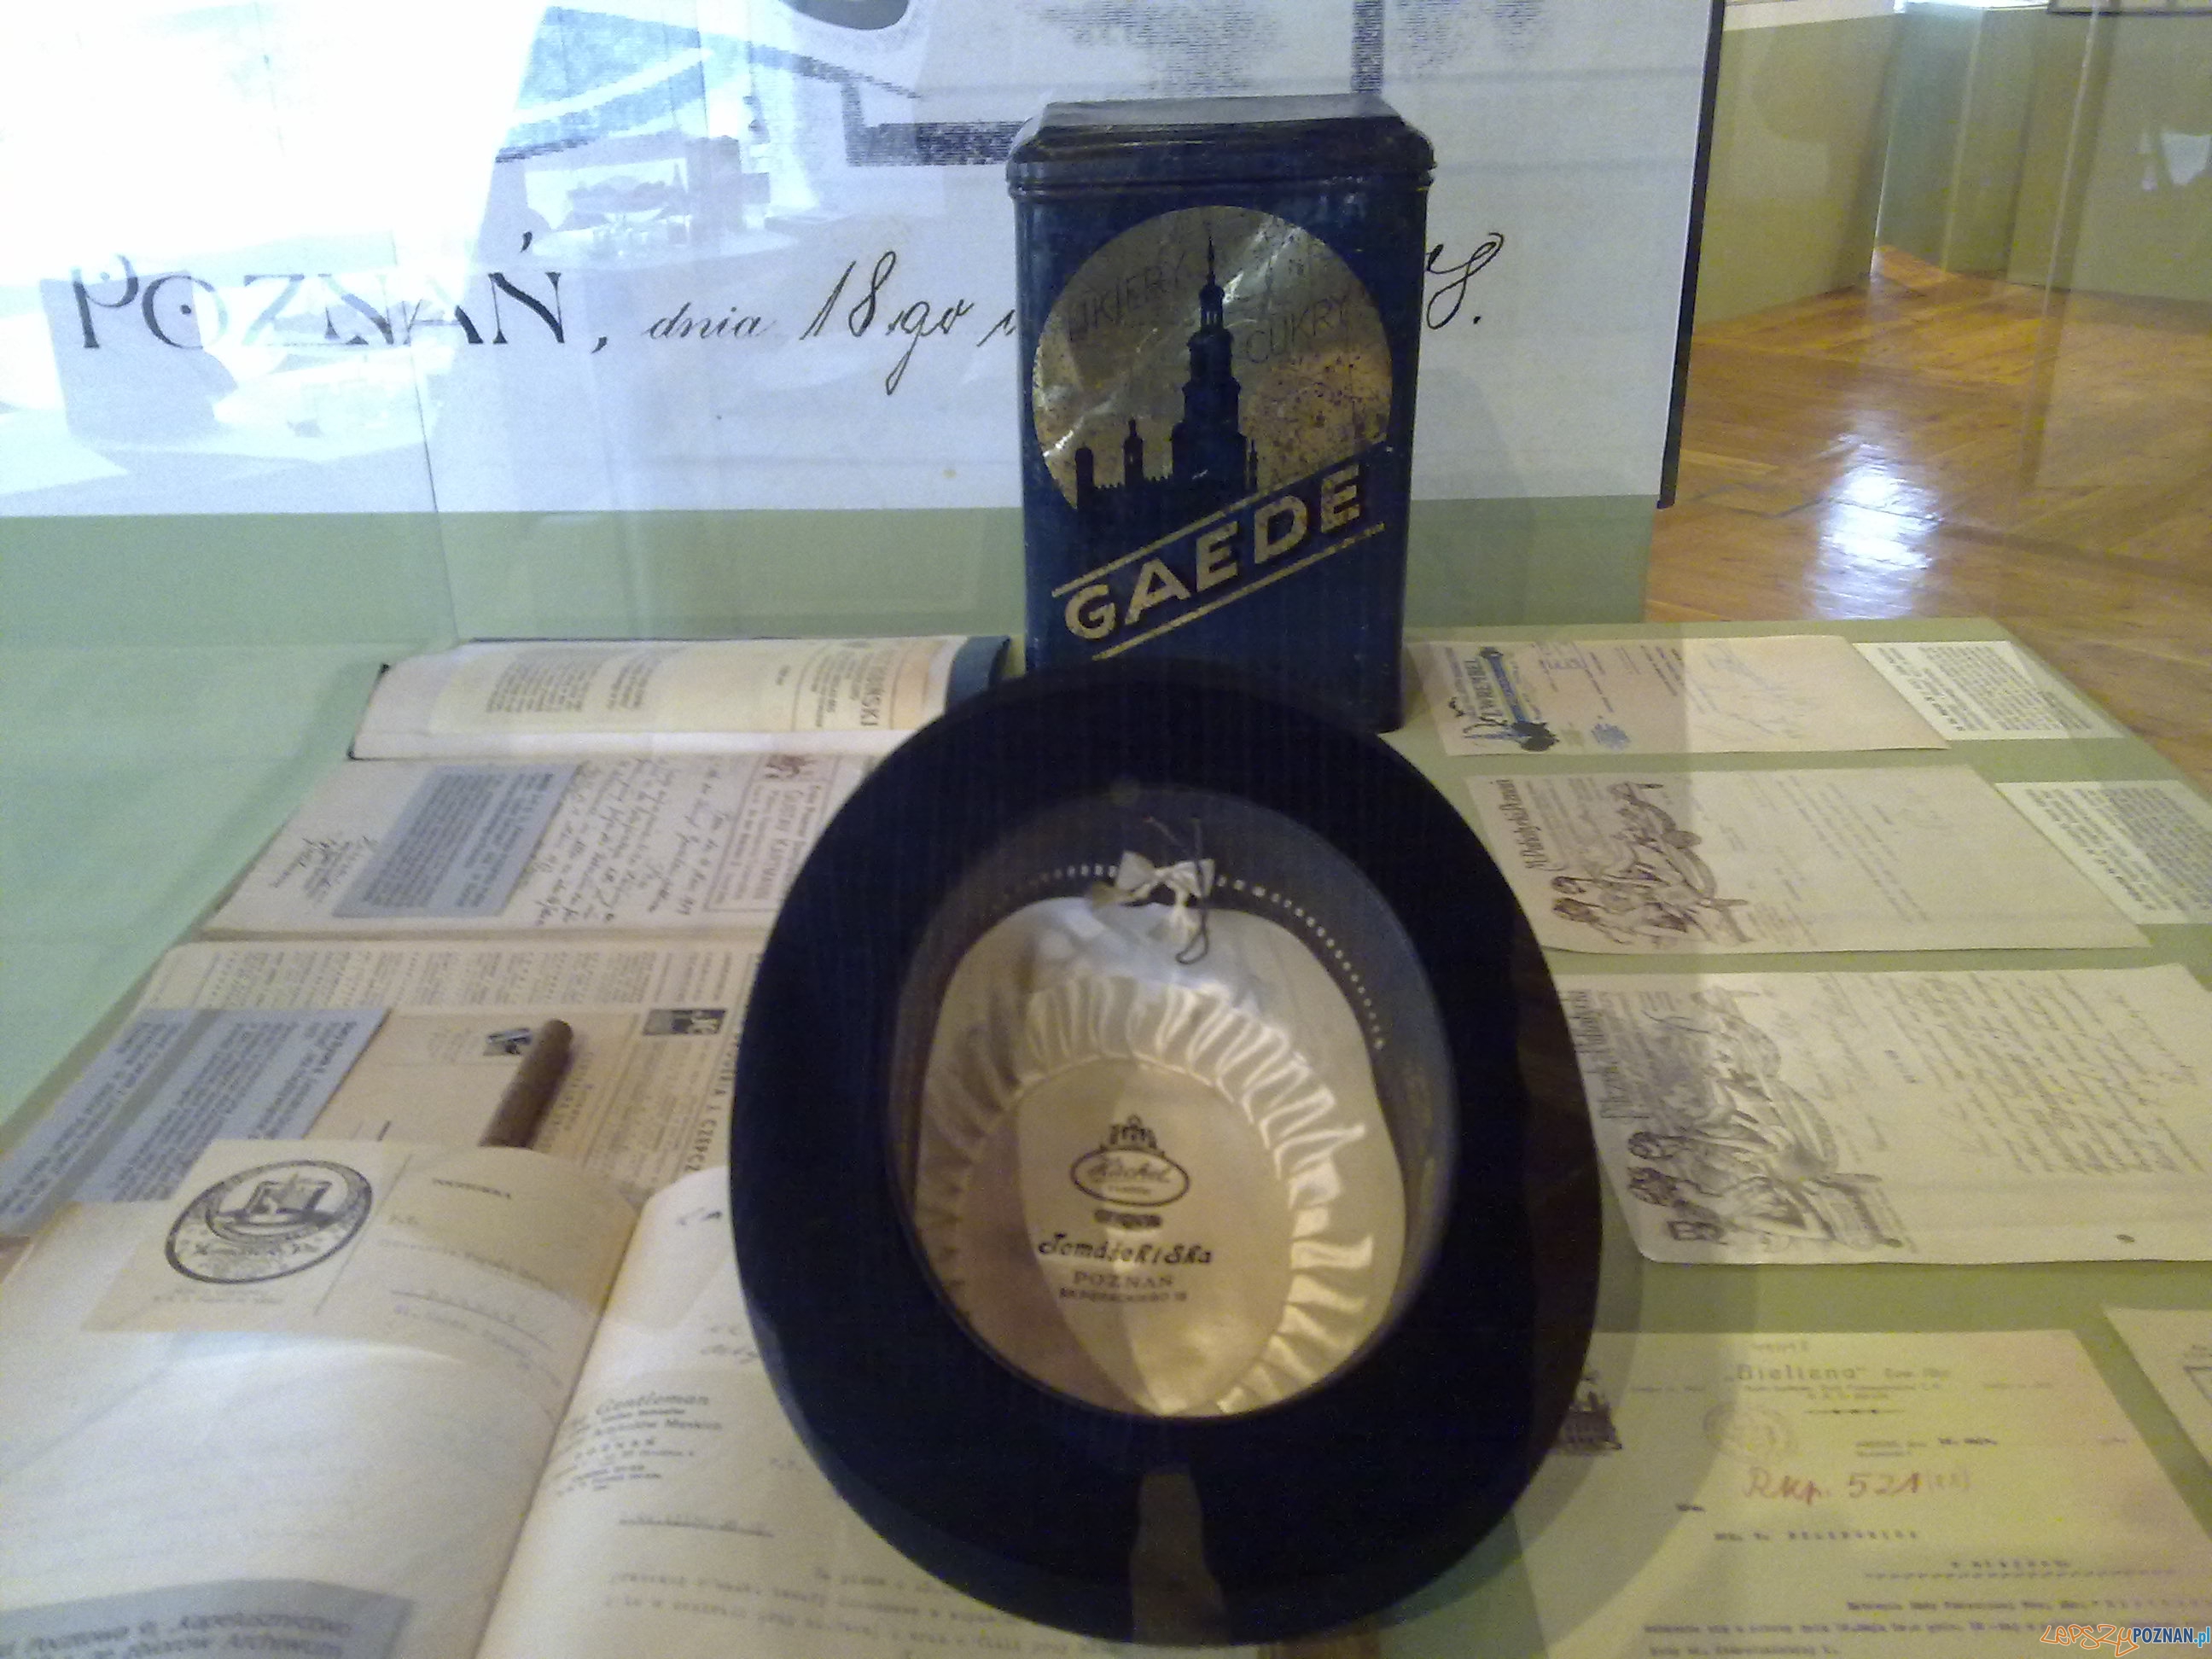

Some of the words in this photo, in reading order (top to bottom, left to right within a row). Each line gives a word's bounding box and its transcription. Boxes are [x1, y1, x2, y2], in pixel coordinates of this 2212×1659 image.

[646, 302, 773, 340] dnia
[1244, 292, 1352, 364] CUKRY
[1063, 463, 1360, 641] GAEDE
